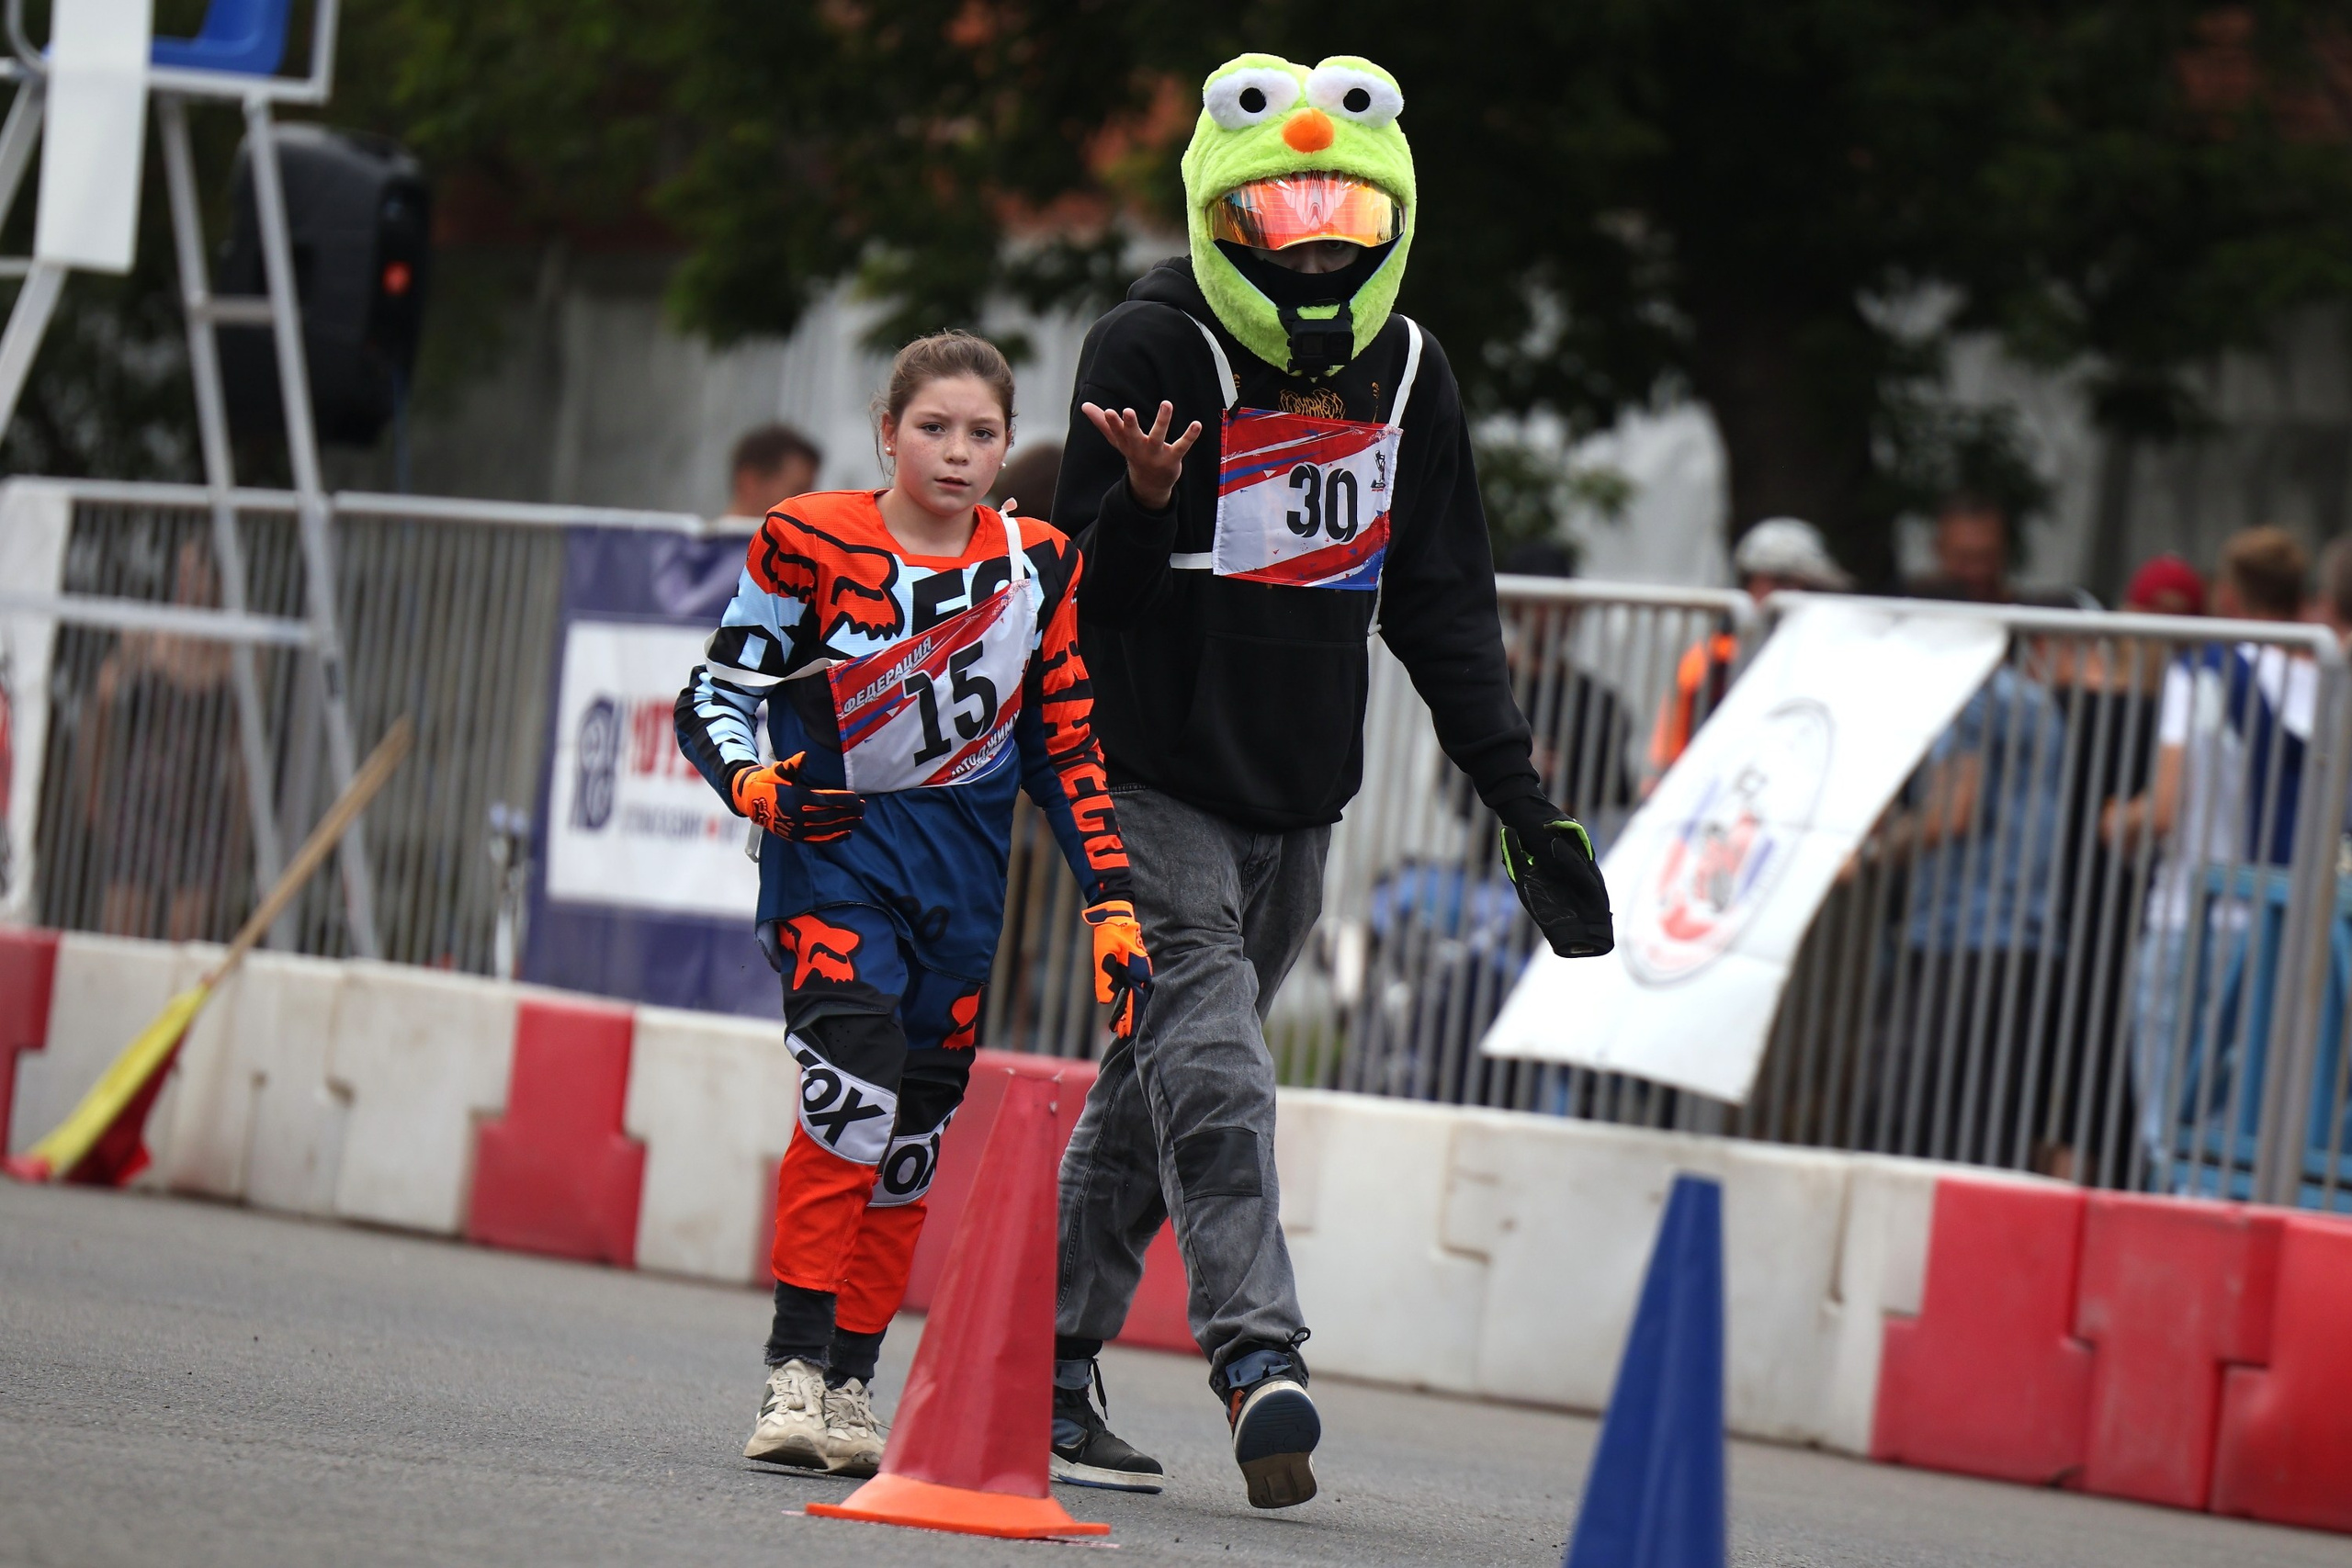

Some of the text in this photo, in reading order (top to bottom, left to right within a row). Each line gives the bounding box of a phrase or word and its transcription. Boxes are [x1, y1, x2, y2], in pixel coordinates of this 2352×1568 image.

[1285, 463, 1359, 543] 30
[843, 635, 933, 714] ФЕДЕРАЦИЯ
[904, 639, 998, 768] 15
